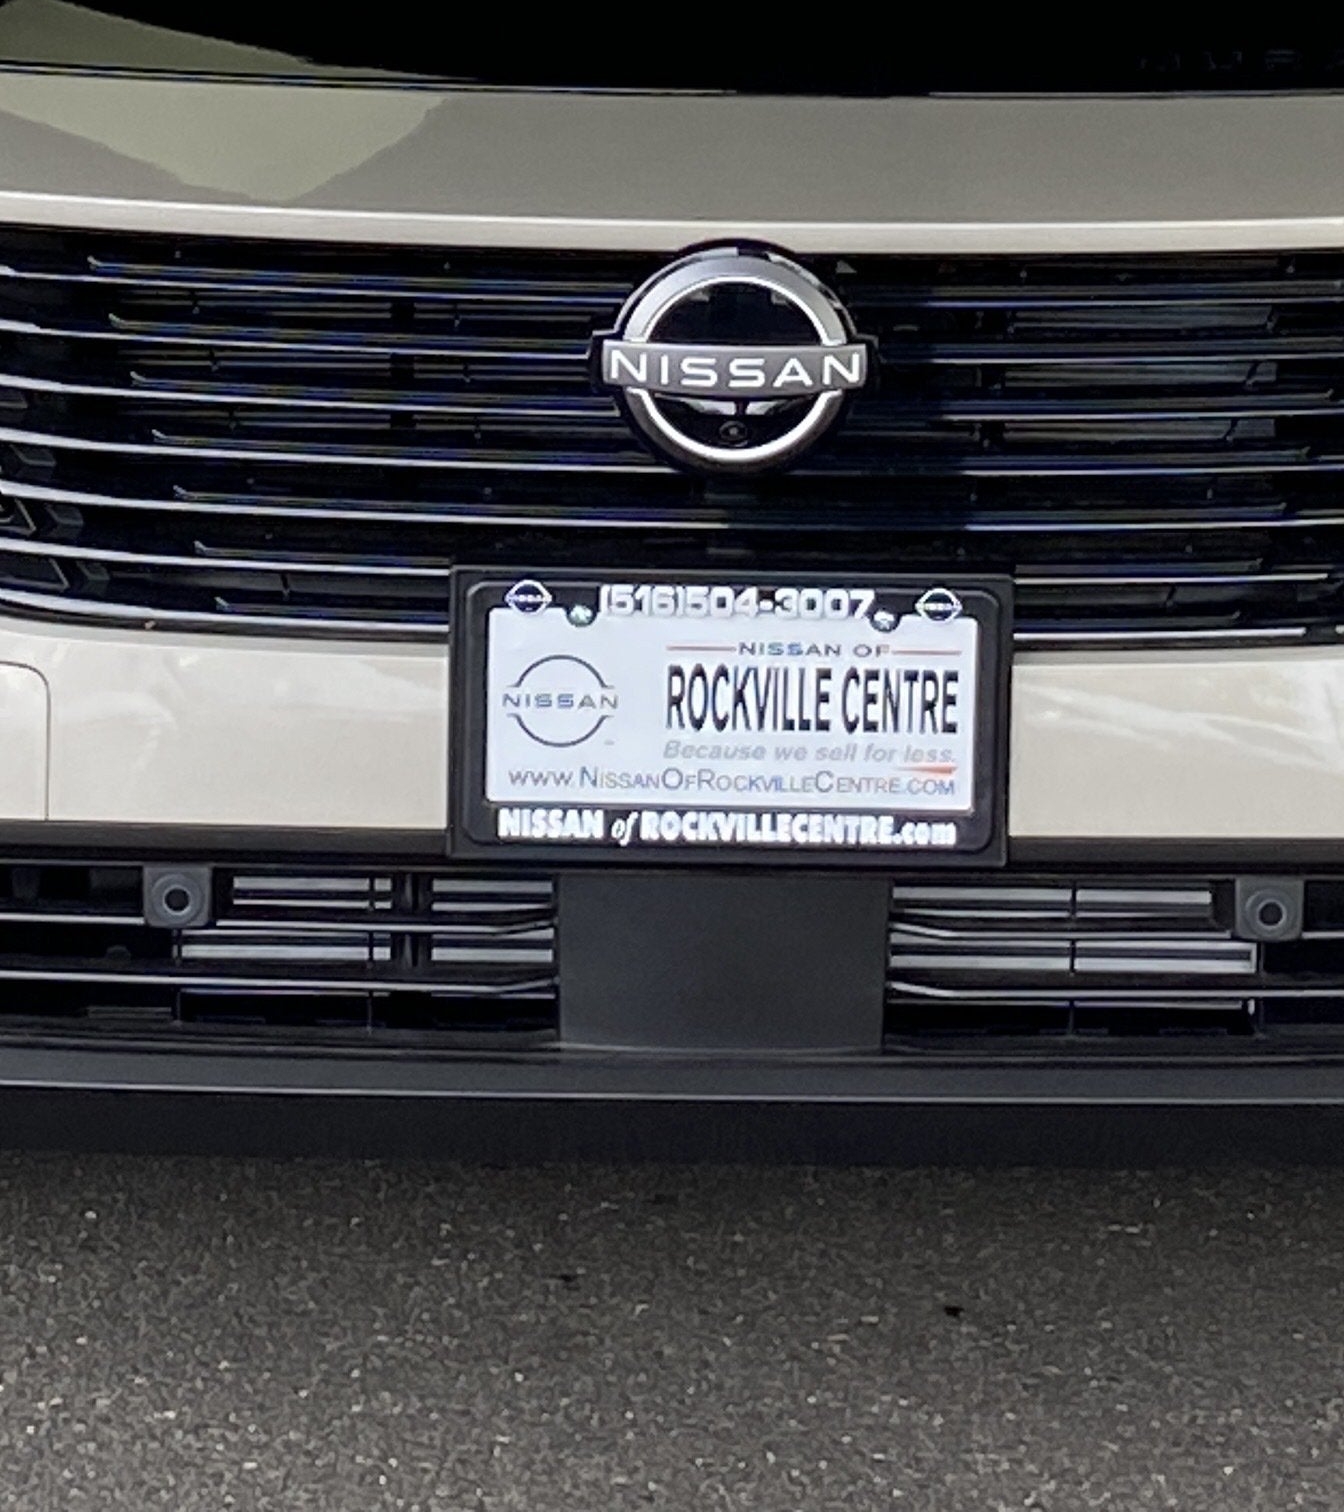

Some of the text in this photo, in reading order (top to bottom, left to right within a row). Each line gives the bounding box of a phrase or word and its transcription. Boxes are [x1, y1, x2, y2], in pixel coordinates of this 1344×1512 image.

[609, 349, 861, 388] NISSAN
[597, 584, 876, 621] (516)504-3007
[737, 641, 891, 658] NISSAN OF
[501, 692, 619, 710] NISSAN
[665, 662, 959, 735] ROCKVILLE CENTRE
[662, 738, 957, 763] Because we sell for less.
[497, 807, 957, 848] NISSAN of ROCKVILLECENTRE.com
